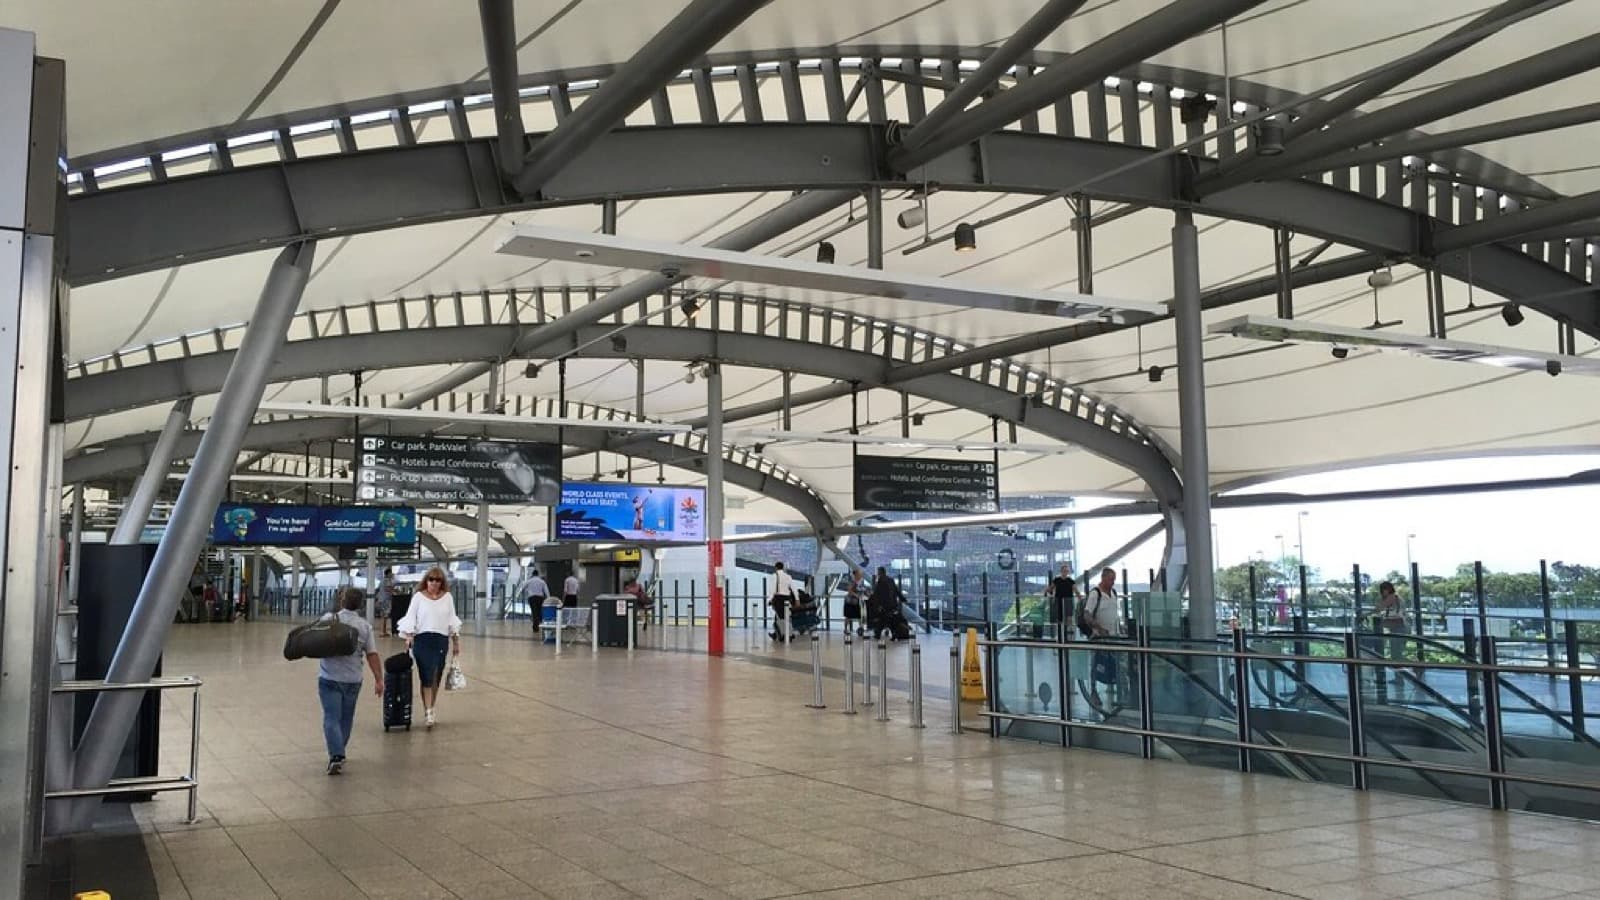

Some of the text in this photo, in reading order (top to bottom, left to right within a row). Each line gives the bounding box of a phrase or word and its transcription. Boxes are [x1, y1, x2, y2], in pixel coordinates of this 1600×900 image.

[391, 441, 405, 450] Car
[407, 442, 427, 452] park,
[429, 442, 467, 452] ParkValet
[401, 458, 518, 470] Hotels and Conference Centre
[916, 462, 925, 470] Car
[390, 473, 407, 482] Pick
[409, 475, 420, 484] up
[421, 474, 452, 484] waiting
[402, 489, 424, 500] Train,
[424, 490, 440, 499] Bus
[441, 490, 456, 499] and
[459, 490, 484, 500] Coach
[266, 517, 290, 525] You're
